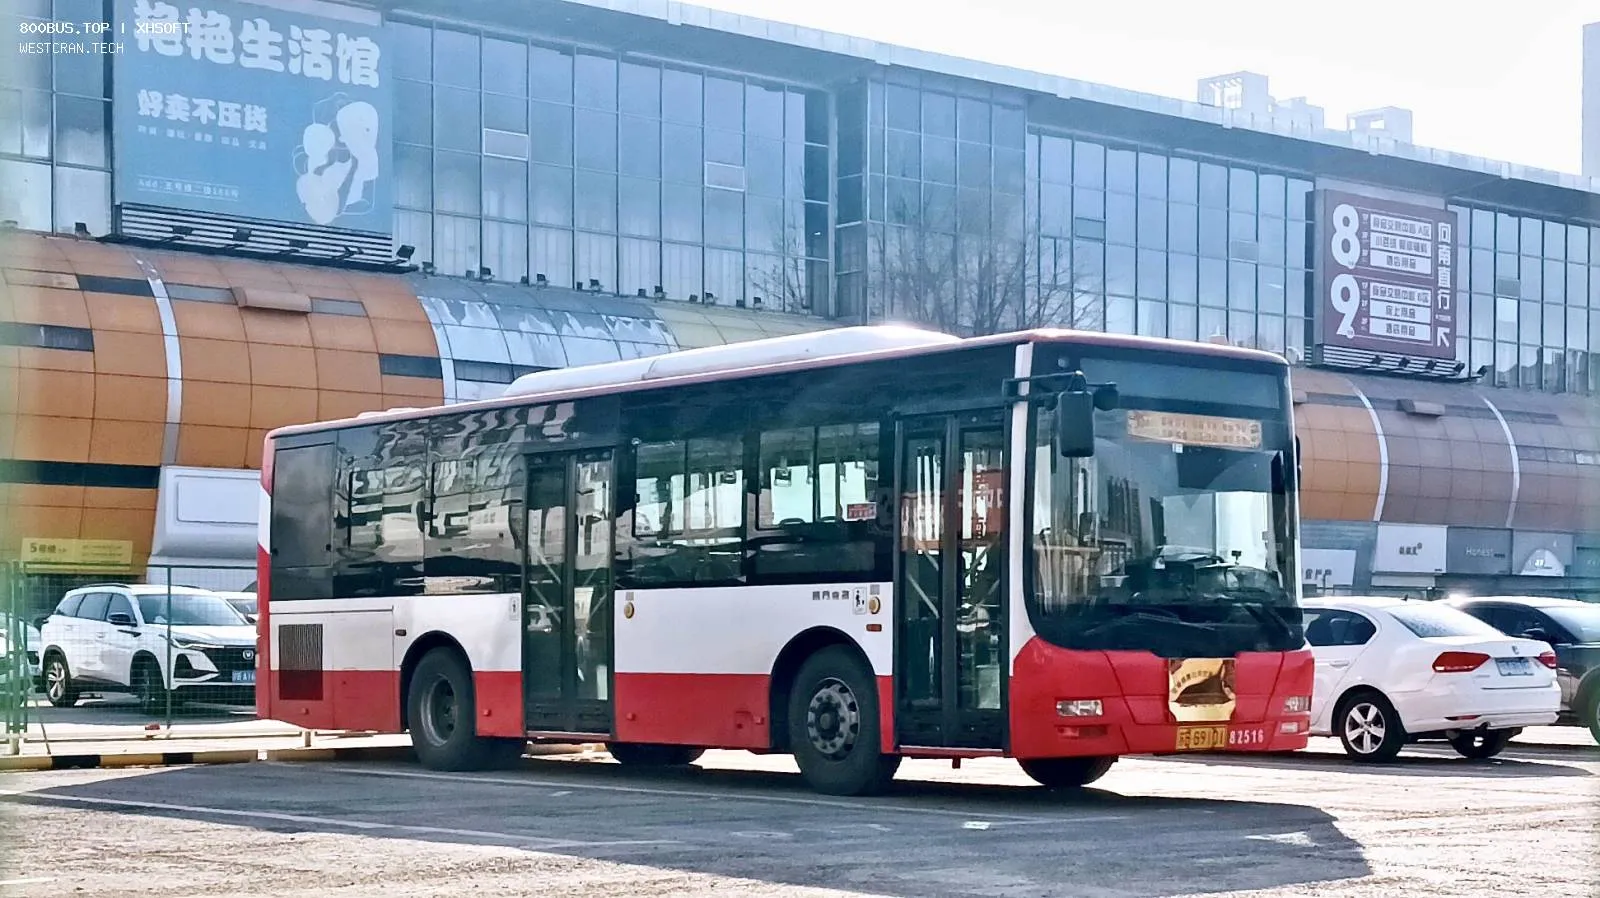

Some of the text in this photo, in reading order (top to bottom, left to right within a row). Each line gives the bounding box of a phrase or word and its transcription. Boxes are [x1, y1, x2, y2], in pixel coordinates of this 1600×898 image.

[137, 89, 267, 133] 好卖不压货
[1331, 203, 1360, 268] 8
[1330, 273, 1360, 336] 9
[1229, 729, 1264, 745] 82516
